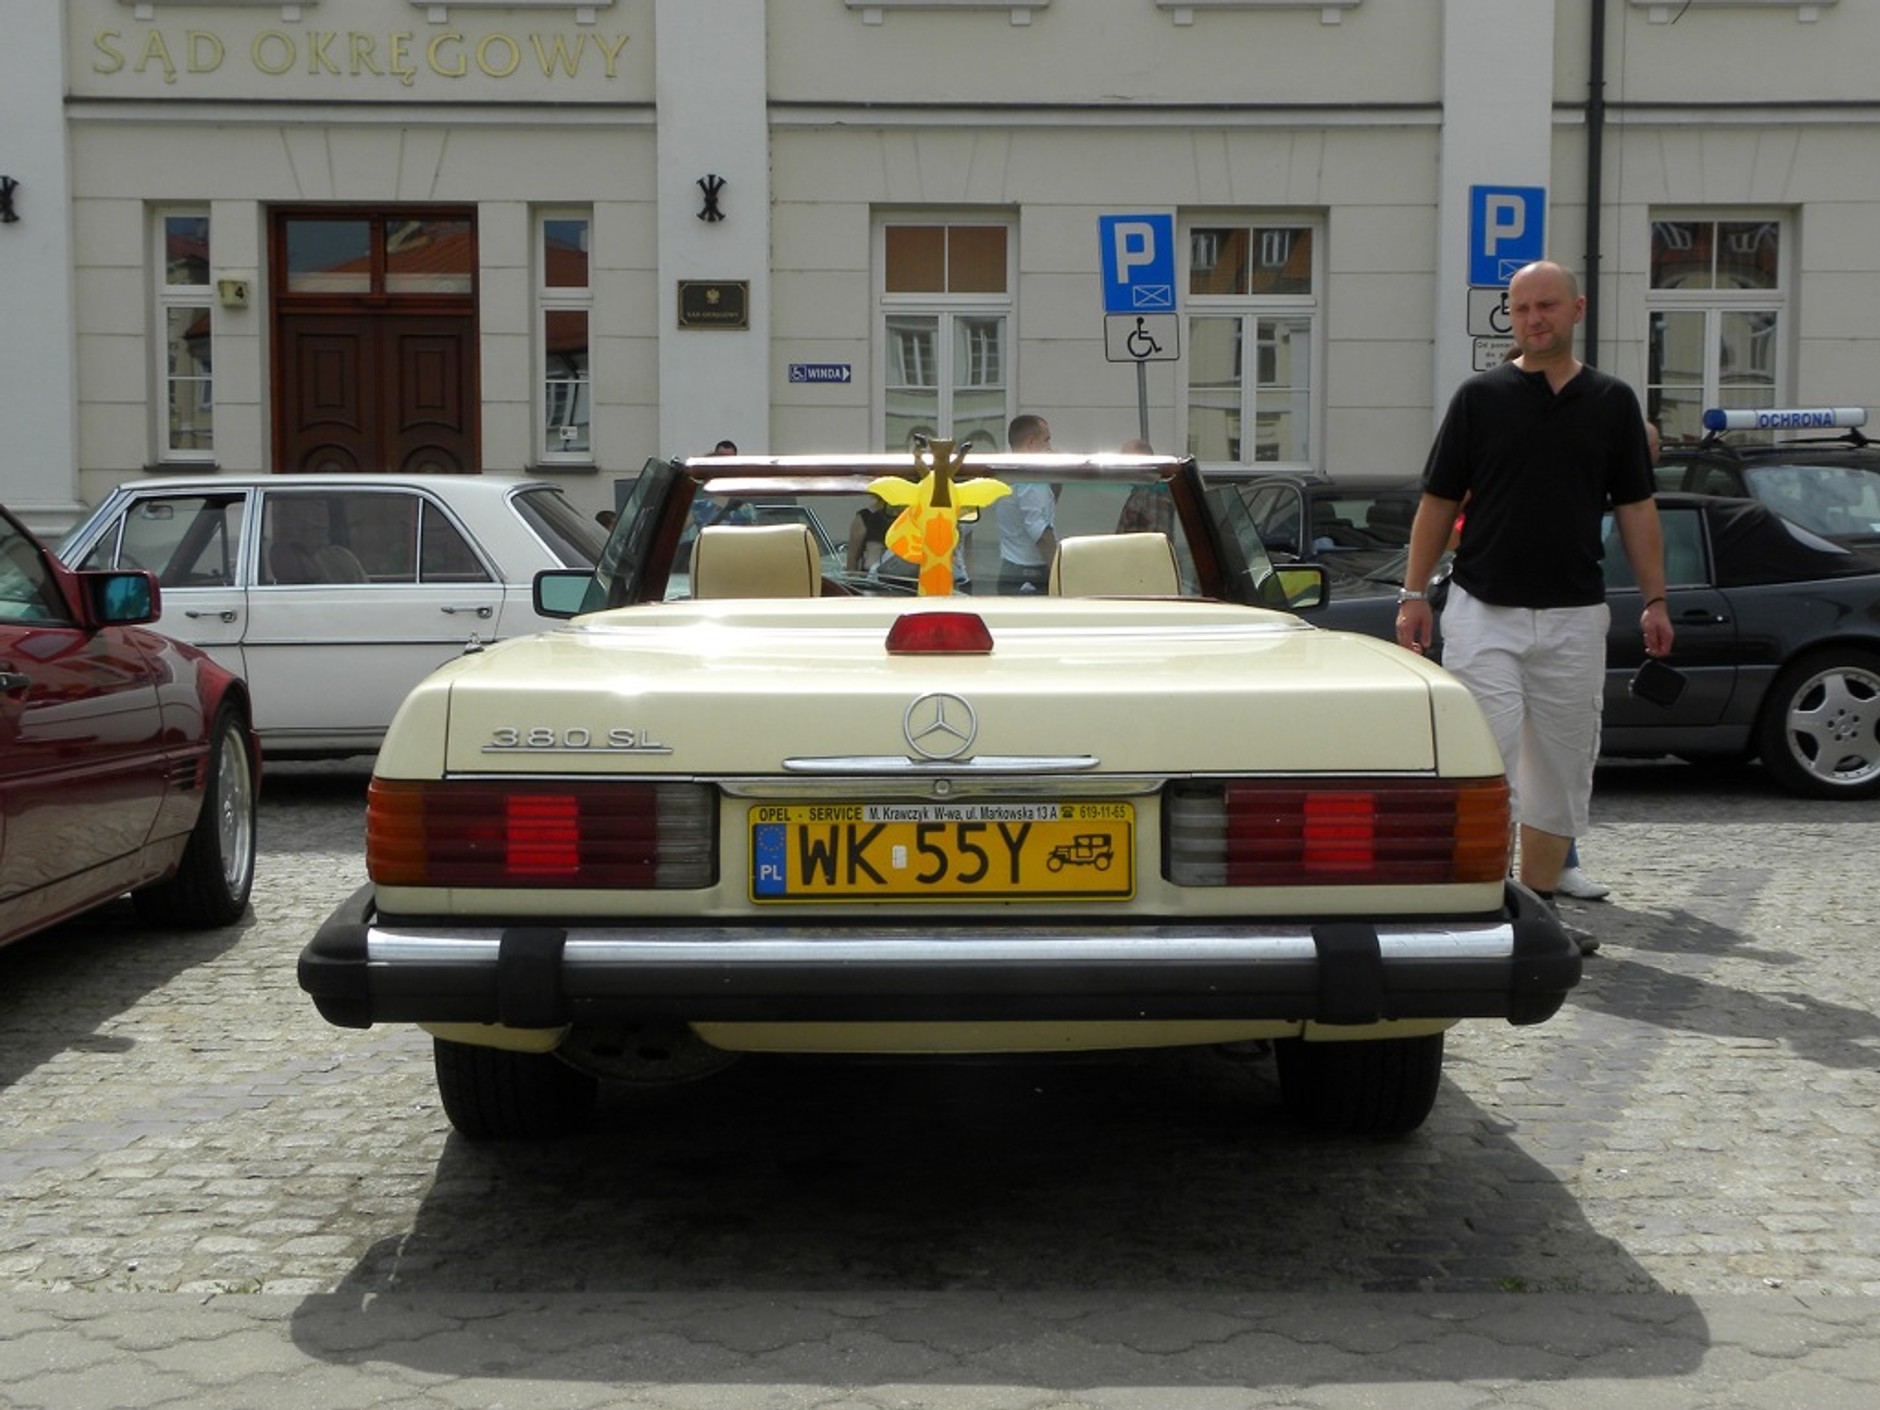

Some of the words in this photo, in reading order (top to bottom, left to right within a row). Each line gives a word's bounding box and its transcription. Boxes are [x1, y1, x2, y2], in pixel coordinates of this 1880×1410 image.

[93, 30, 225, 84] SĄD
[251, 30, 629, 86] OKRĘGOWY
[1485, 194, 1525, 256] P
[1114, 222, 1155, 284] P
[235, 286, 244, 299] 4
[807, 367, 843, 379] WINDA
[1759, 413, 1832, 428] OCHRONA
[493, 727, 591, 748] 380
[607, 728, 664, 748] SL
[759, 807, 791, 821] OPEL
[809, 806, 862, 820] SERVICE
[883, 806, 929, 821] Krawczyk
[980, 806, 1033, 819] Markowska
[1037, 806, 1048, 819] 13
[1050, 806, 1057, 819] A
[799, 823, 888, 886] WK
[916, 822, 1032, 884] 55Y
[760, 865, 782, 881] PL
